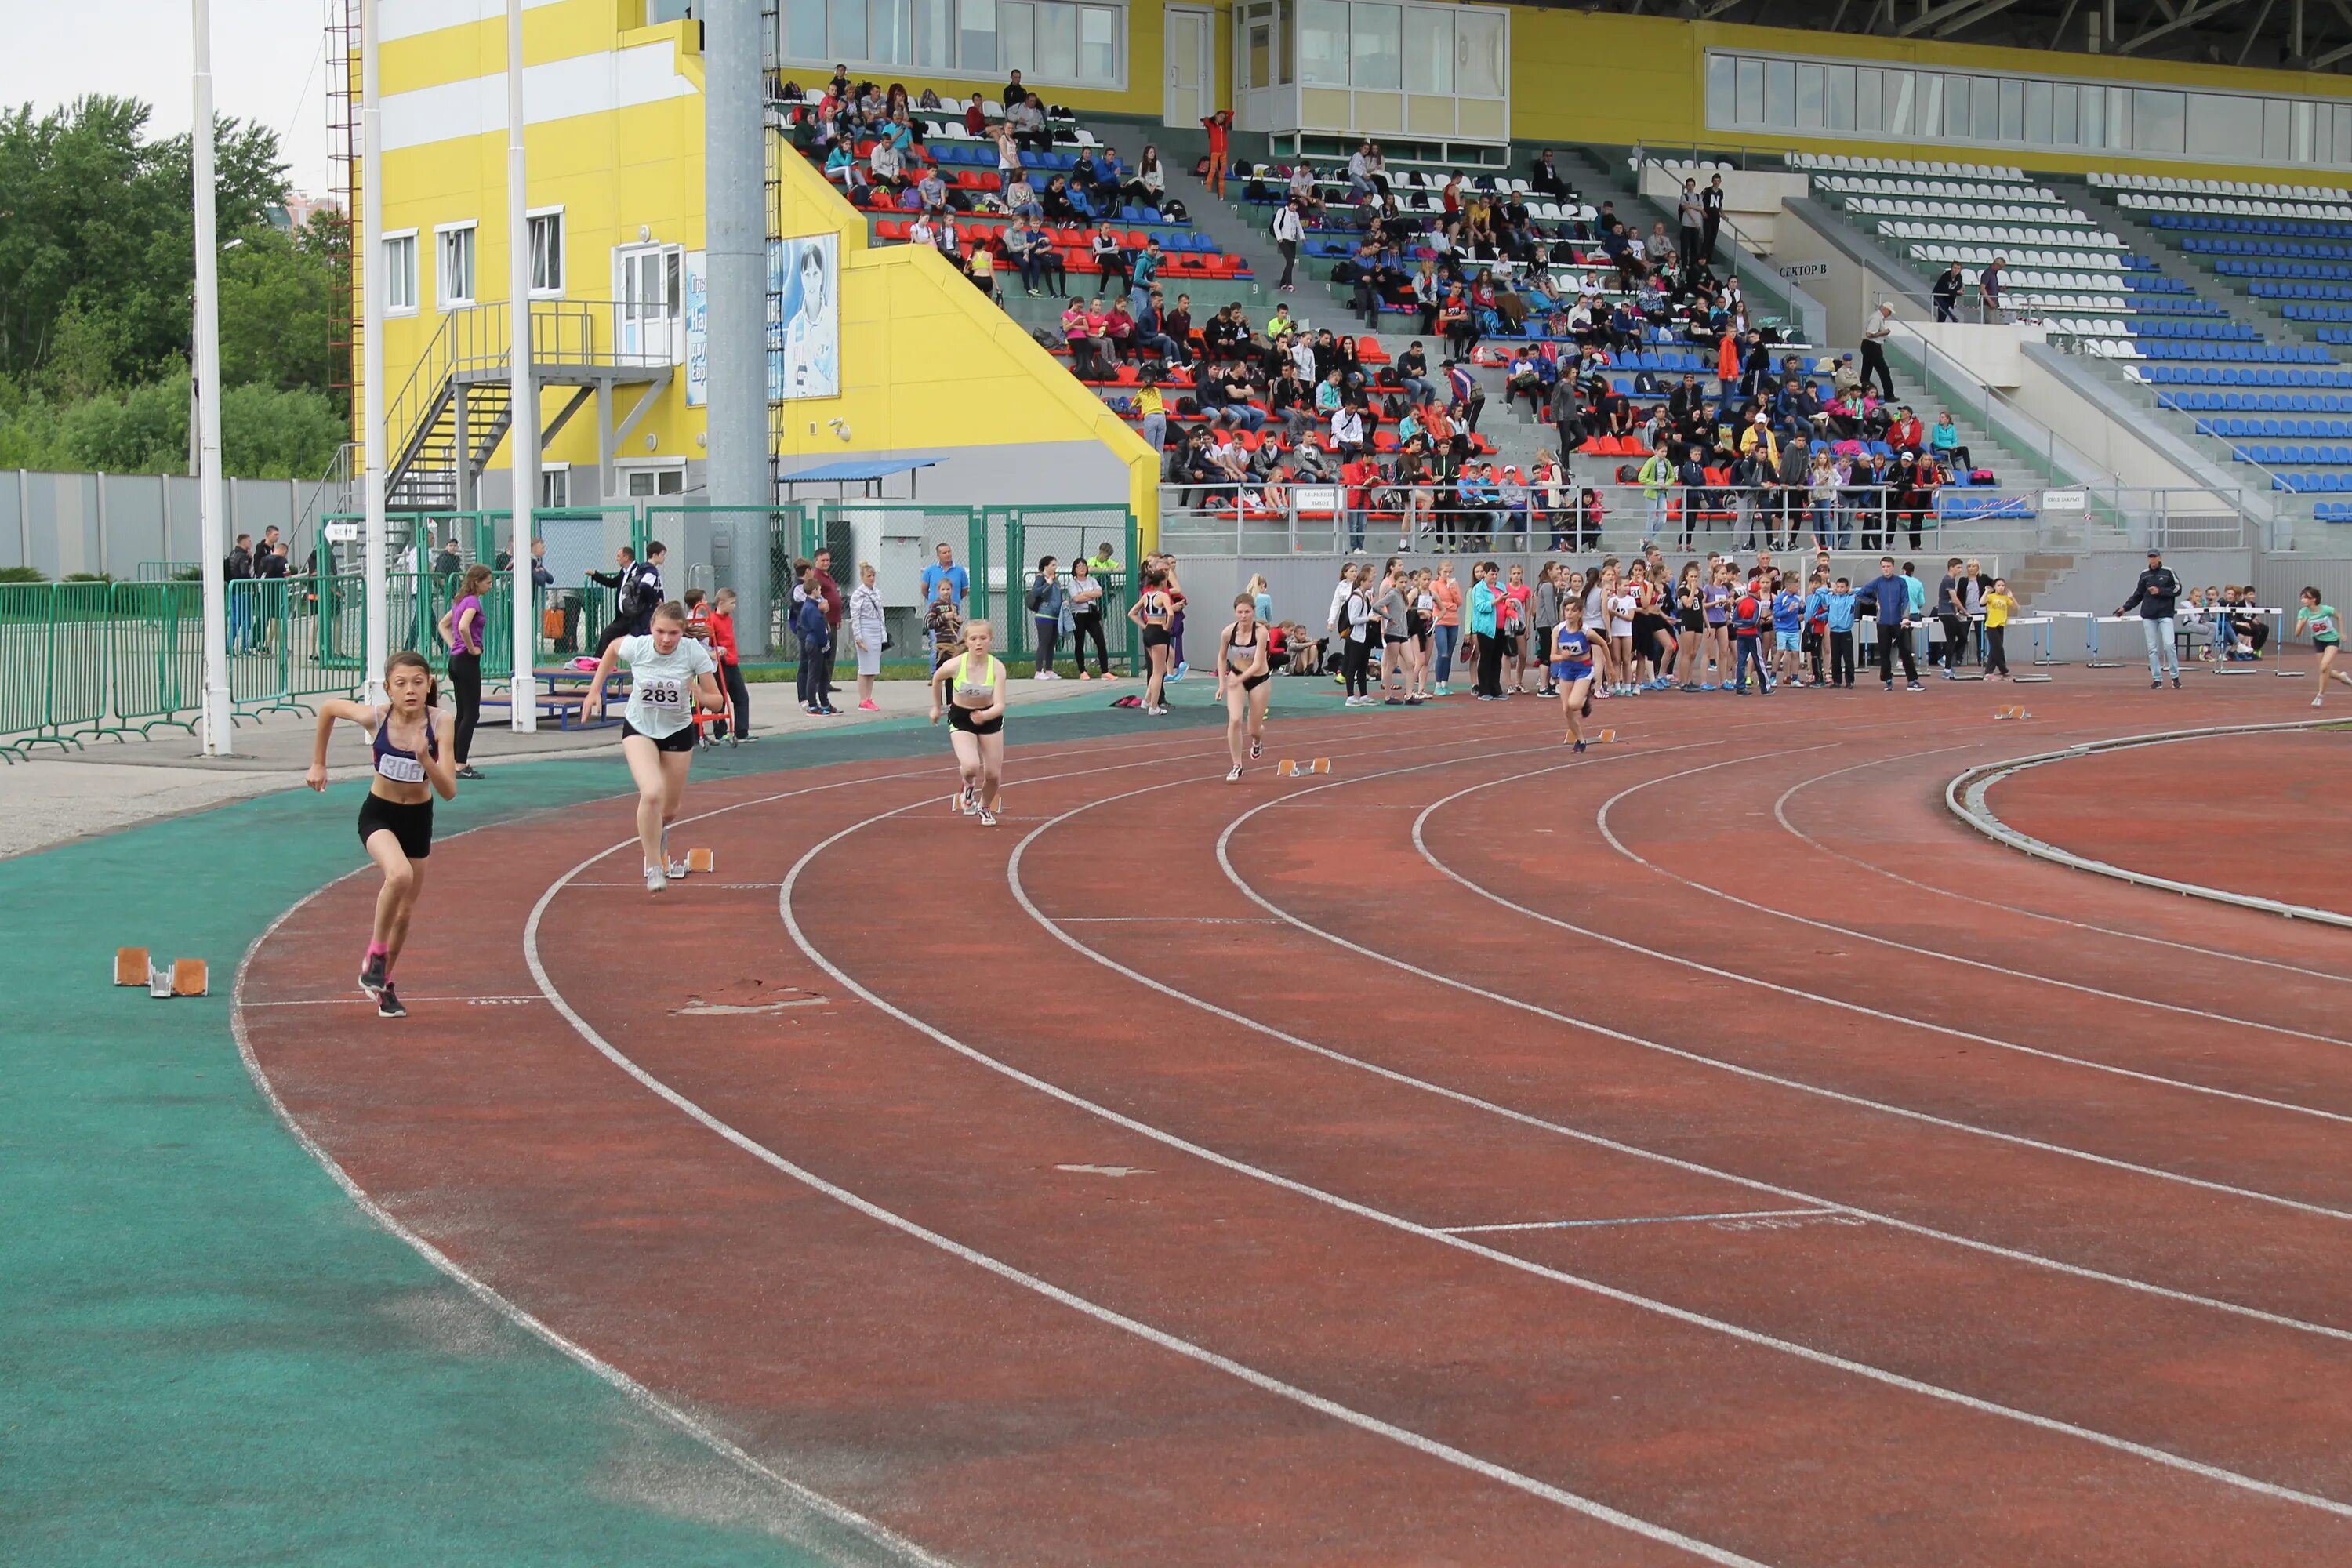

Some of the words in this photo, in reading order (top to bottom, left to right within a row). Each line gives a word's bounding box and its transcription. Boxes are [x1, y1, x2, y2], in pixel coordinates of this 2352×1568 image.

[1709, 194, 1721, 209] N
[1779, 265, 1817, 278] СЕКТОР
[641, 688, 679, 703] 283
[383, 757, 421, 781] 306
